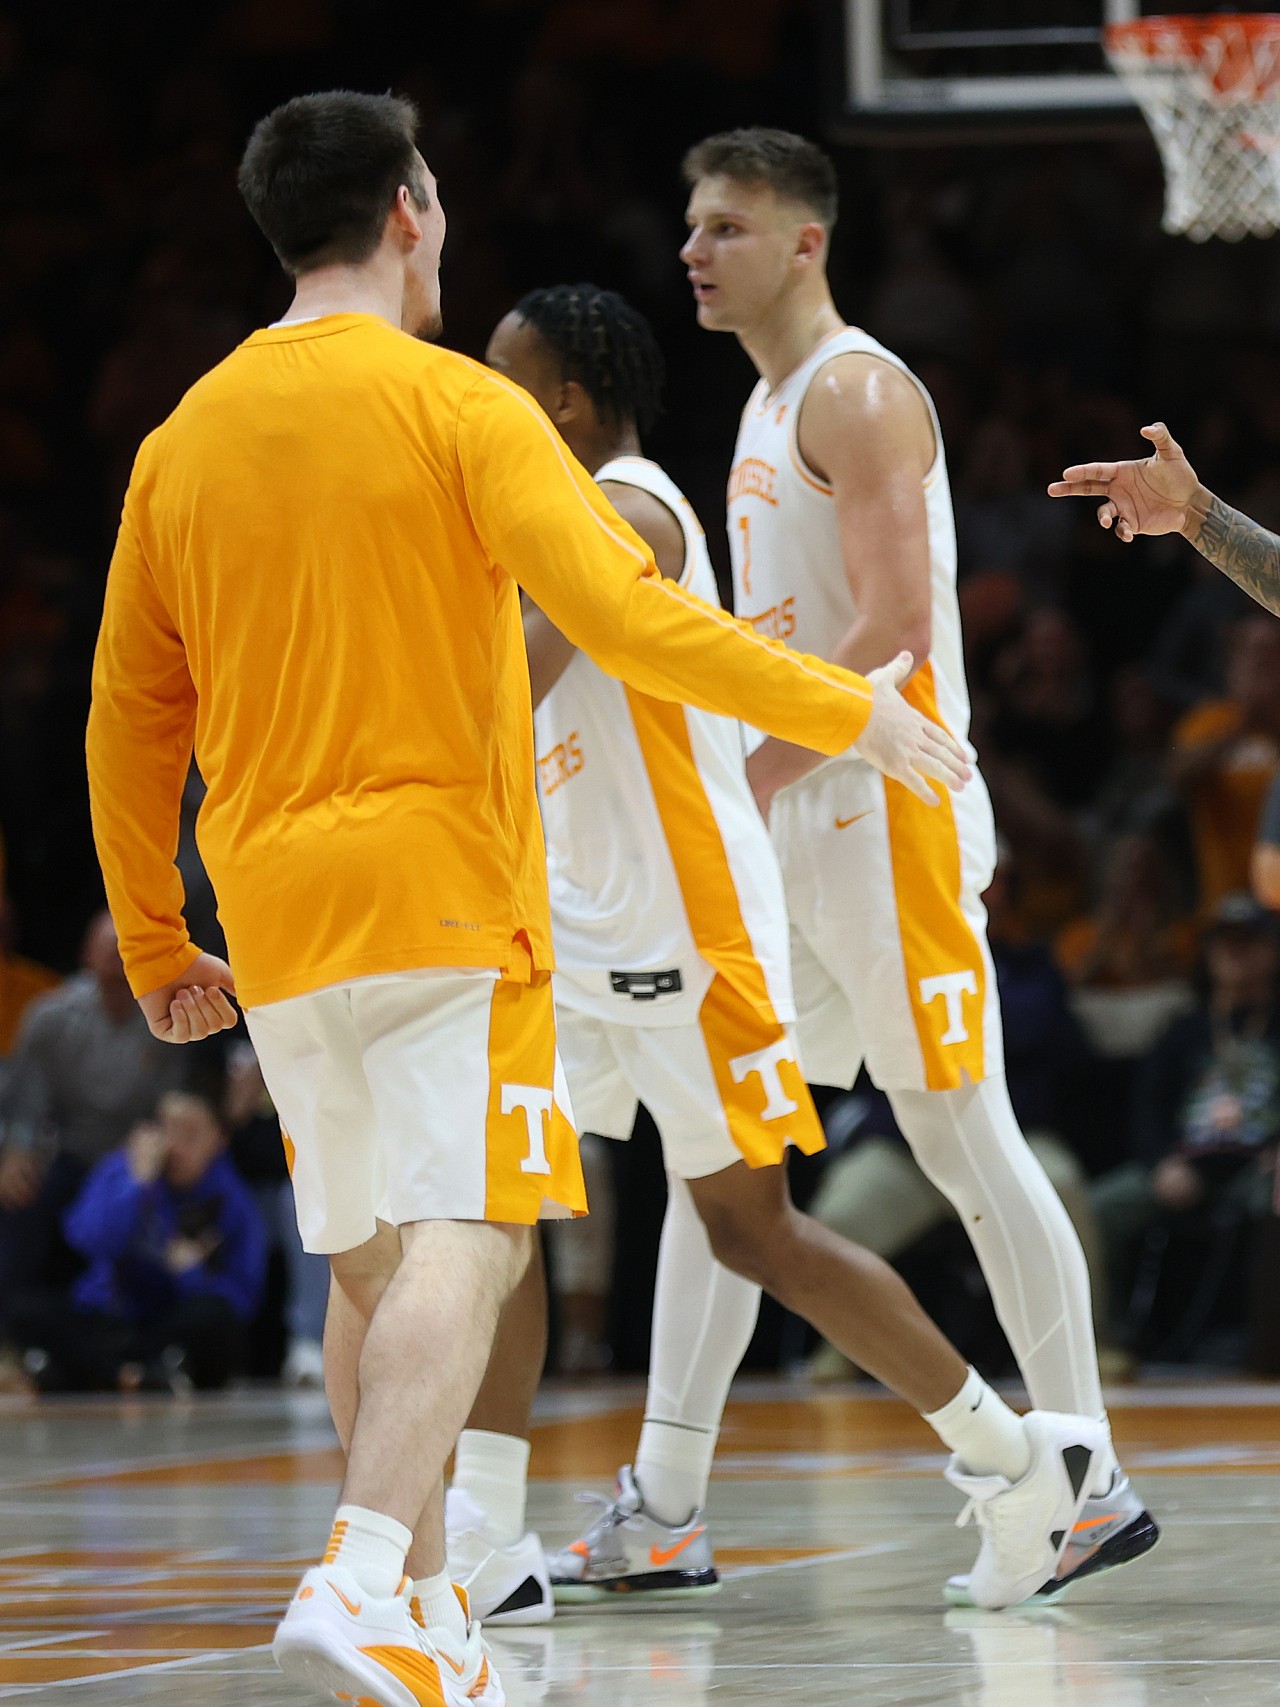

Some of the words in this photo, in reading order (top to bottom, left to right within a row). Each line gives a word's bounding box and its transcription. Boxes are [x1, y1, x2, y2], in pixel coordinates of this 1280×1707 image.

[919, 969, 978, 1046] T
[728, 1037, 798, 1122] T
[501, 1083, 553, 1176] T
